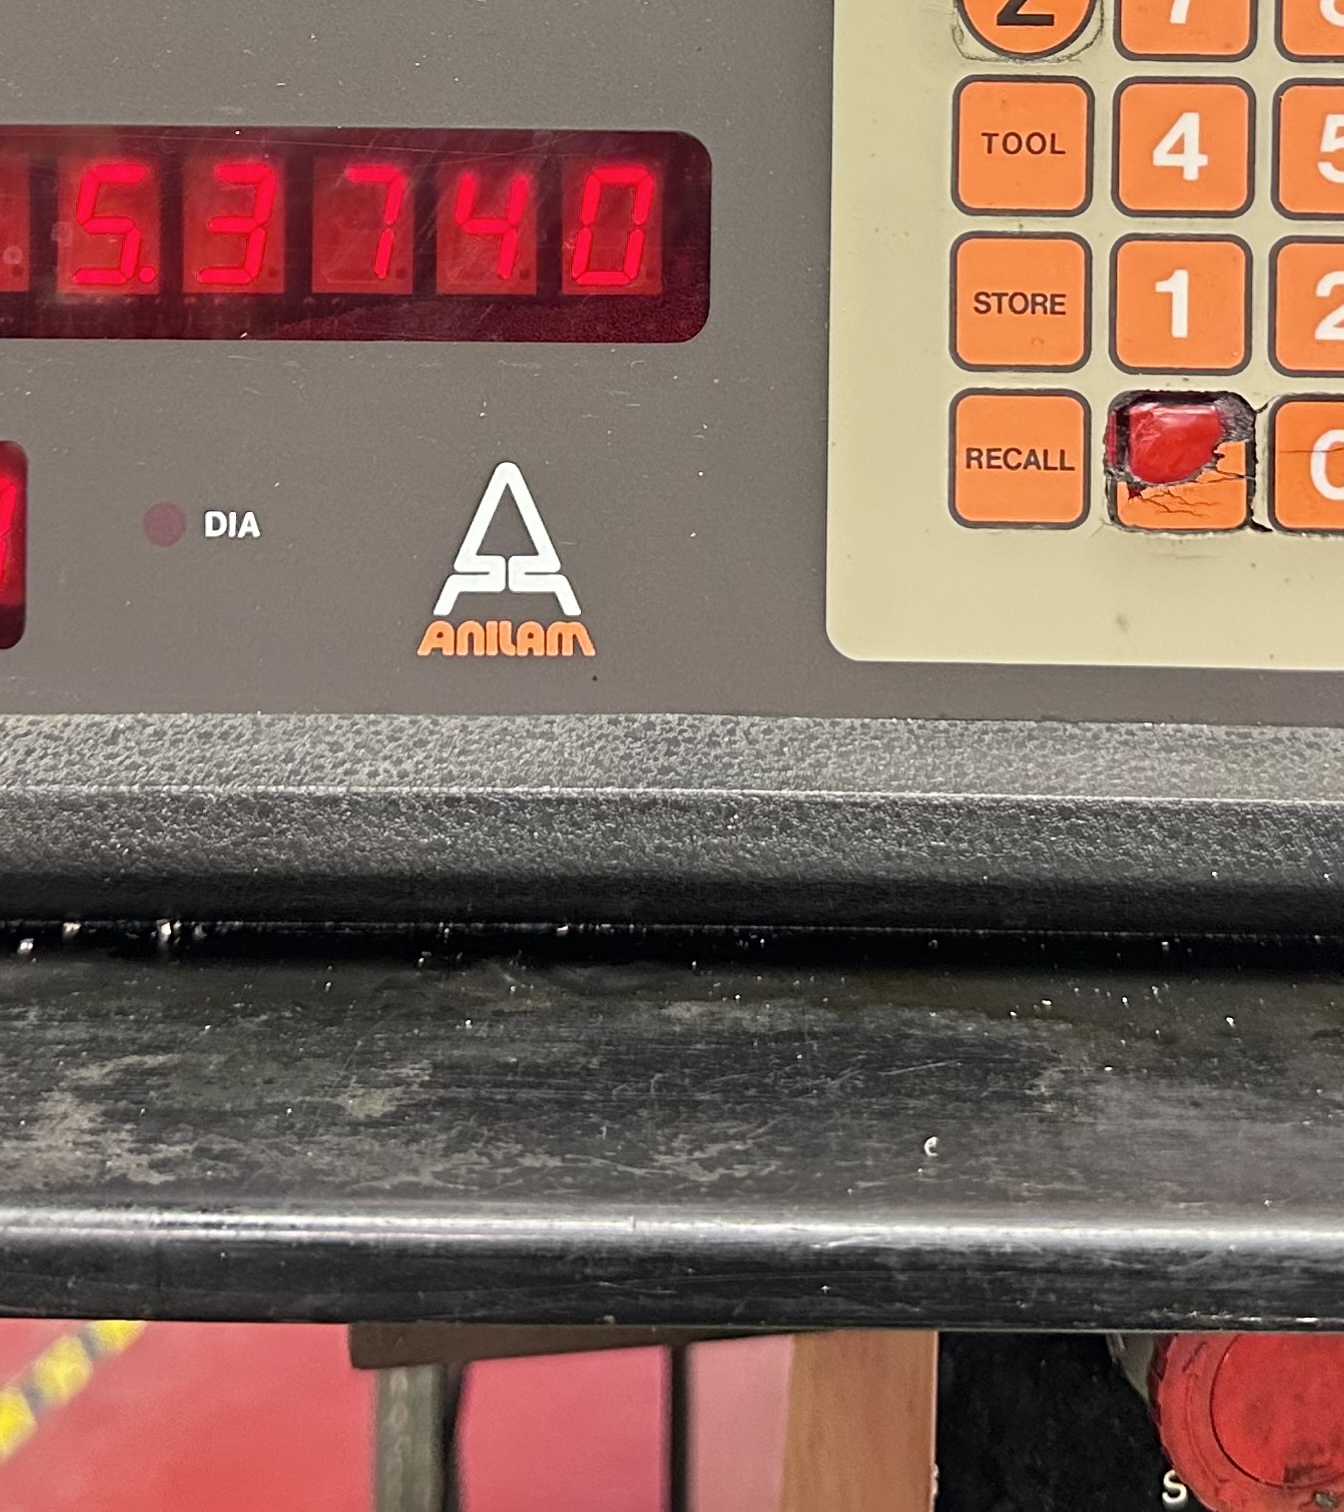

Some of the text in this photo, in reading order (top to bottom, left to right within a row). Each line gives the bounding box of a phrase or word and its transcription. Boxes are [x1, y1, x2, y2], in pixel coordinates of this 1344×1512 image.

[979, 130, 1068, 156] TOOL
[1151, 111, 1210, 182] 4
[972, 290, 1068, 317] STORE
[1154, 268, 1190, 339] 1
[964, 446, 1077, 473] RECALL
[203, 510, 262, 539] DIA
[417, 619, 596, 658] ANILAM
